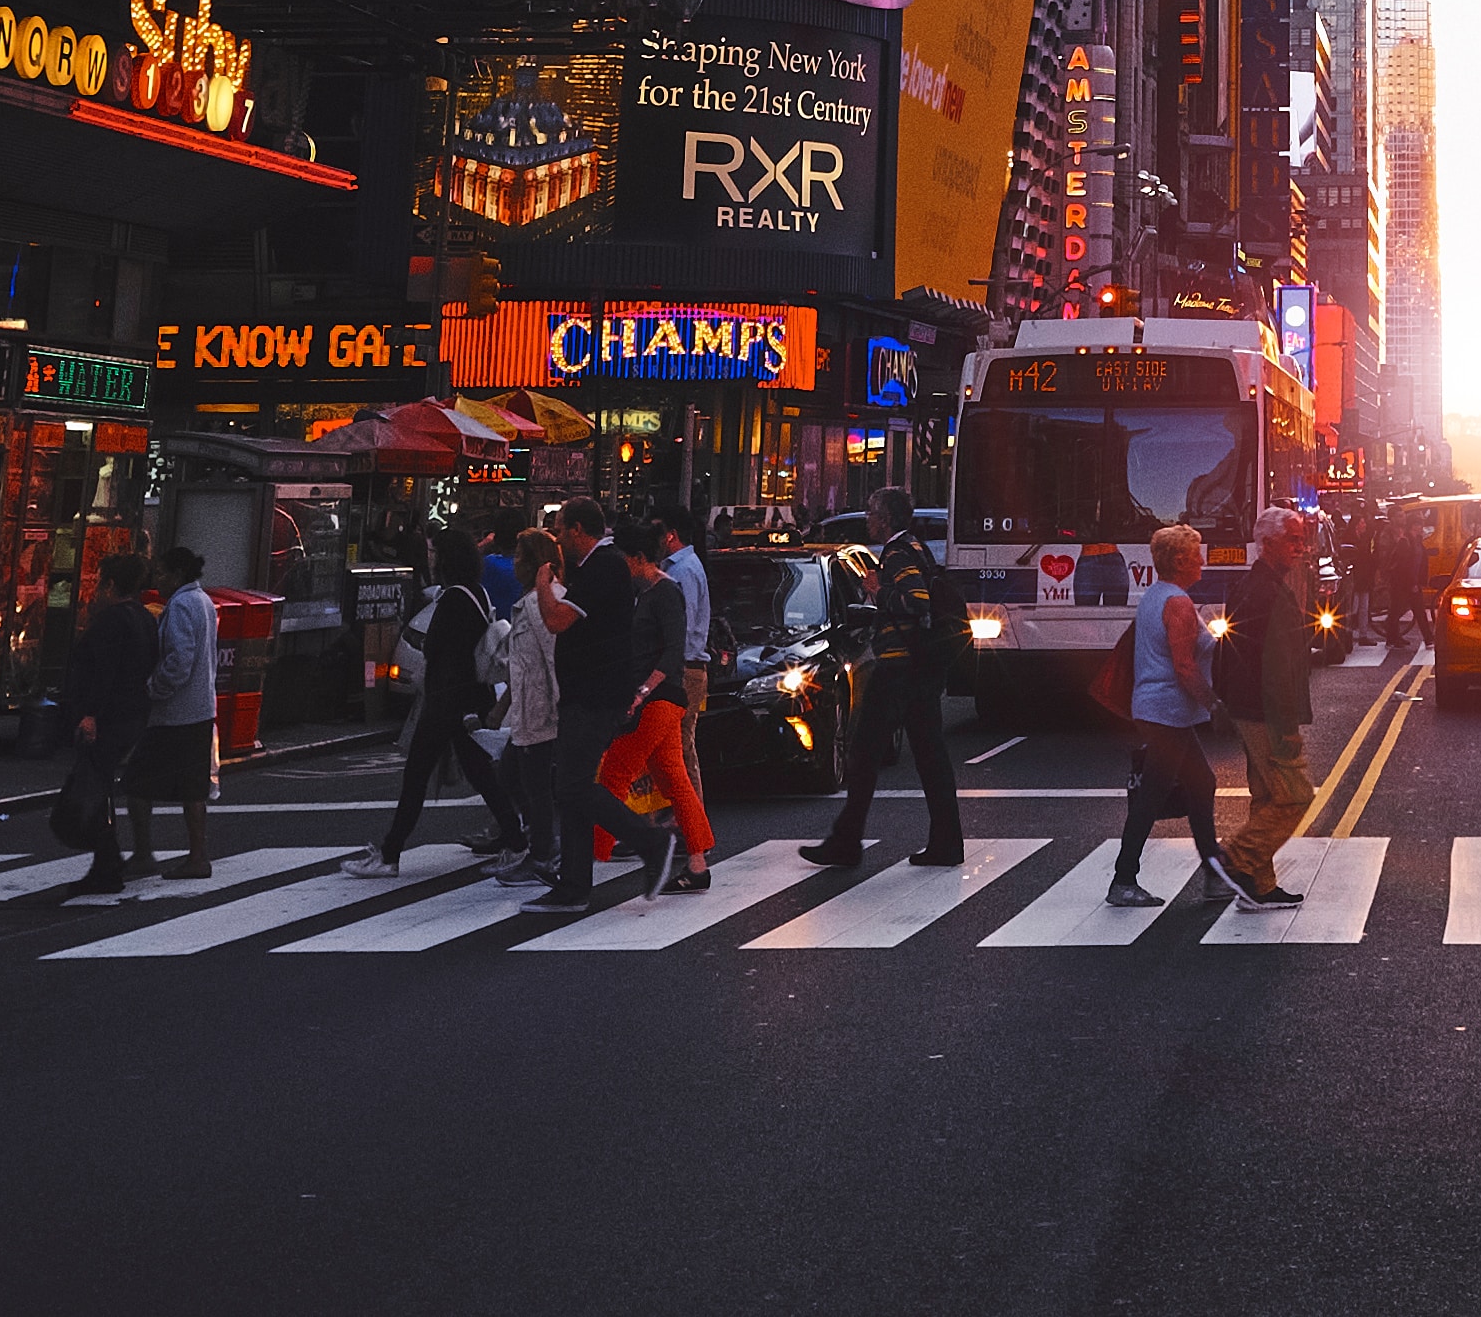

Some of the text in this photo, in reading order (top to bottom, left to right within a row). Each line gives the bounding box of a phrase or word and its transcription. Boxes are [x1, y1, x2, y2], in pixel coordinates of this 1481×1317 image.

[28, 28, 45, 63] Q
[58, 37, 73, 74] R
[87, 51, 106, 87] W
[768, 40, 822, 76] New
[827, 47, 867, 84] York
[908, 42, 933, 110] love
[637, 81, 873, 136] for the 21st Century
[680, 129, 845, 211] RXR
[716, 205, 821, 234] REALTY
[194, 323, 314, 368] KNOW
[549, 313, 788, 375] CHAMPS
[878, 346, 918, 399] CHAMPS
[1008, 361, 1057, 392] M42
[1096, 361, 1167, 377] EAST SIDE
[979, 569, 1006, 580] 3930
